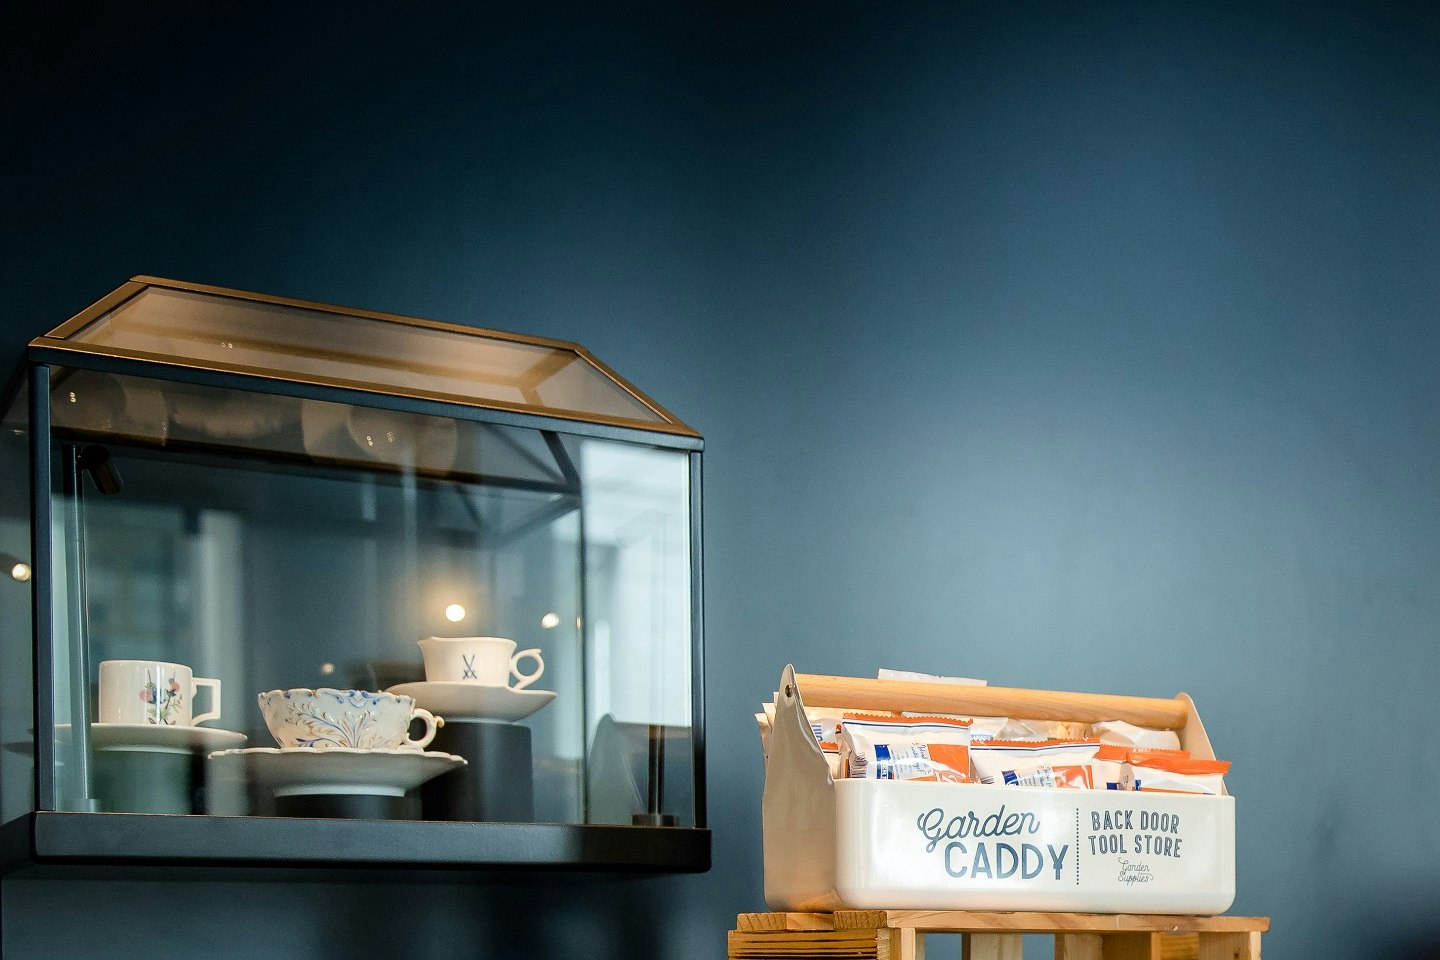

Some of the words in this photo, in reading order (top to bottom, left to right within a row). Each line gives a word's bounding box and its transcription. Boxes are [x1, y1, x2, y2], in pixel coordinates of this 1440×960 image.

[917, 804, 1041, 853] Garden
[1091, 810, 1133, 831] BACK
[1140, 811, 1180, 834] DOOR
[1088, 834, 1127, 855] TOOL
[1134, 834, 1183, 858] STORE
[944, 841, 1069, 880] CADDY
[1118, 857, 1150, 876] Garden
[1118, 871, 1154, 887] Supplies
